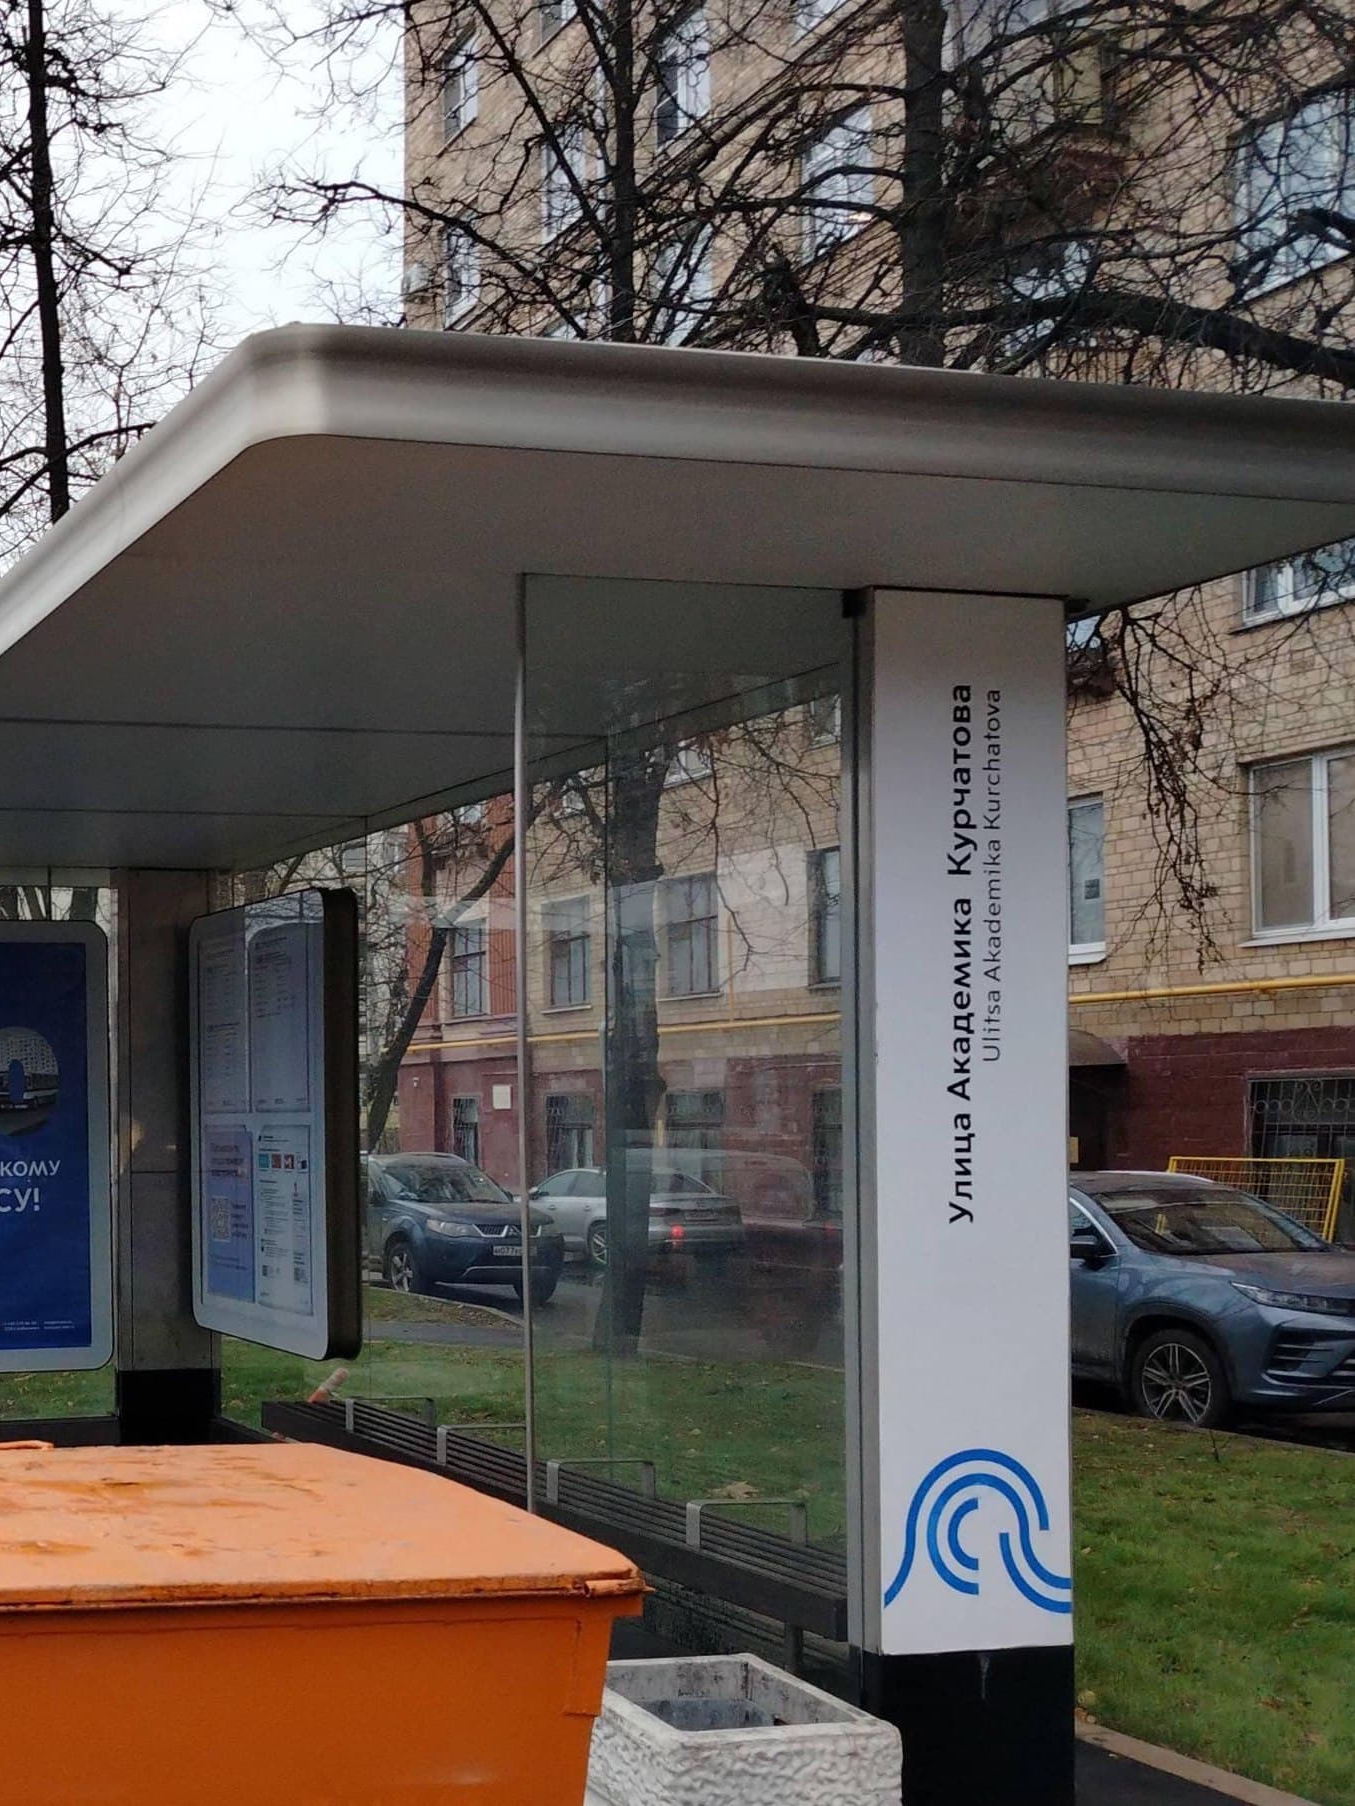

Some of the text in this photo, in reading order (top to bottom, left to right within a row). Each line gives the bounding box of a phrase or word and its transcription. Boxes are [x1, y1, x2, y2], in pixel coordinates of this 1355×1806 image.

[946, 684, 978, 1224] Улица Академика Курчатова
[982, 690, 1001, 1062] Ulitsa Akademika Kurchatova
